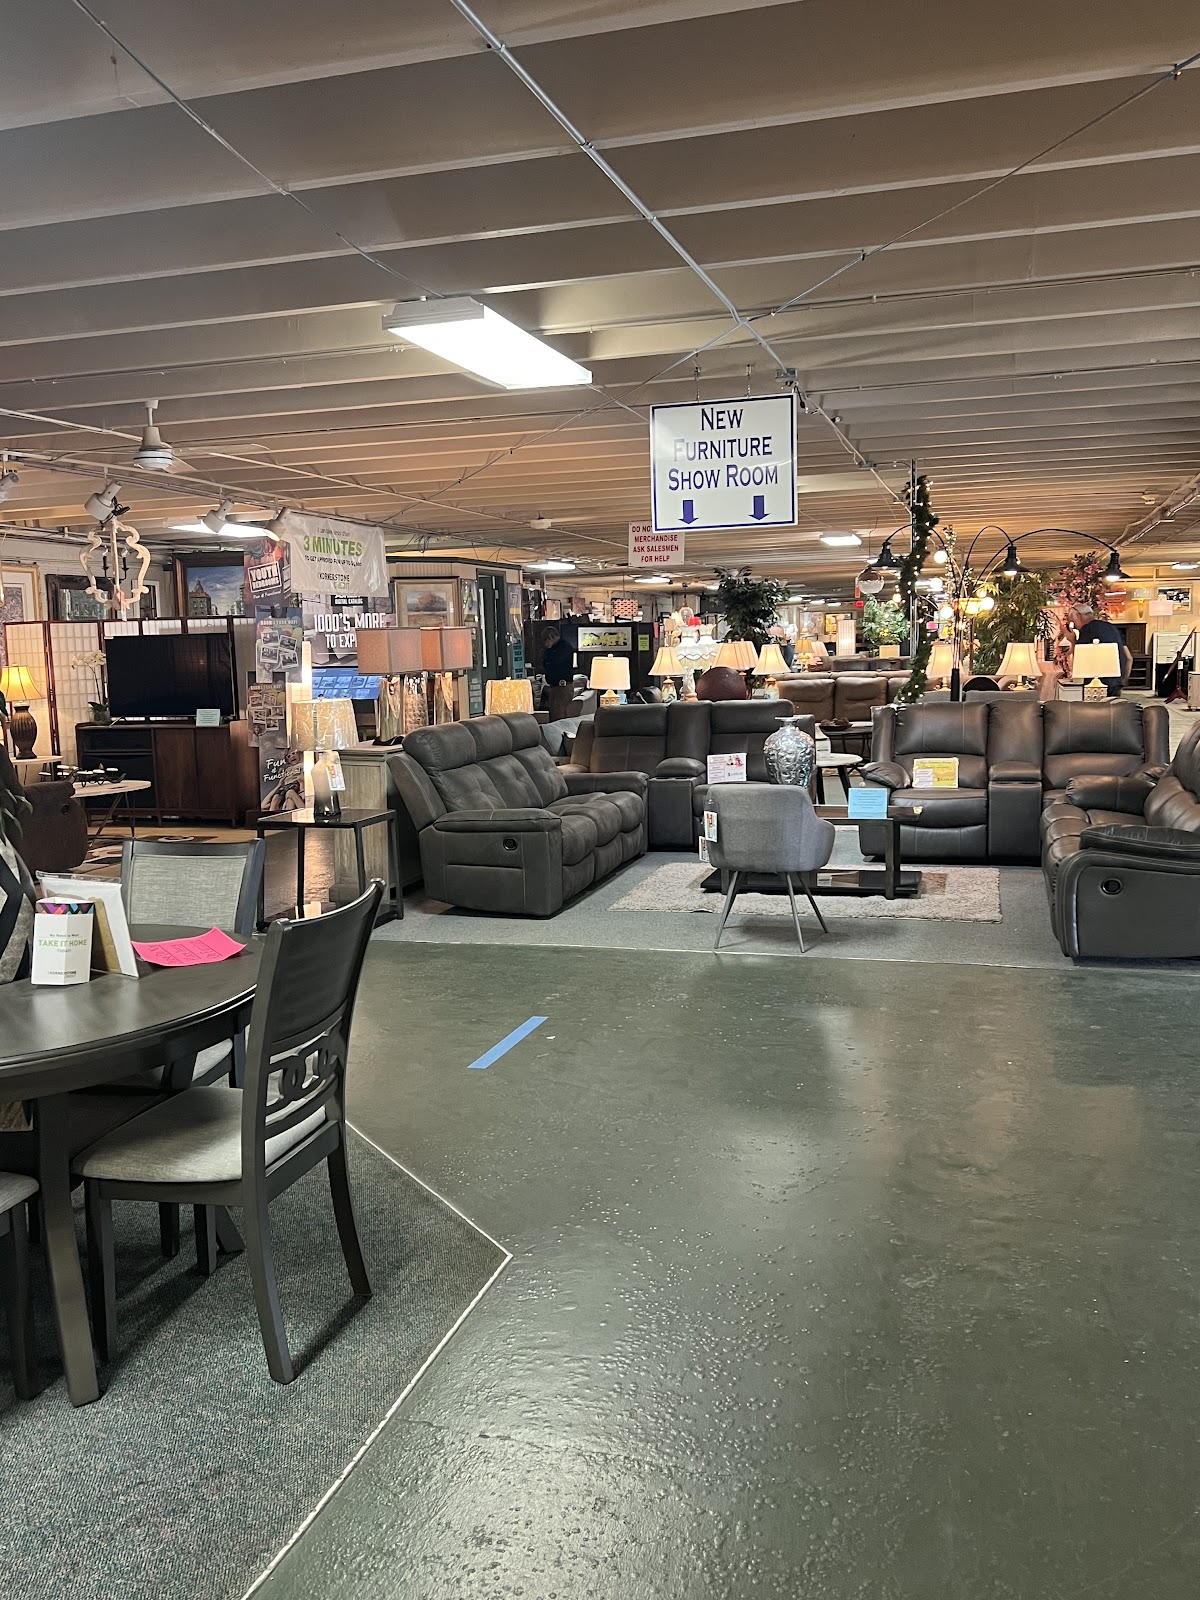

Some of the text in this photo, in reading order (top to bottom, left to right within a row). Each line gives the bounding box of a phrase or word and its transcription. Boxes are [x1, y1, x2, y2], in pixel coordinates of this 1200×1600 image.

[701, 407, 743, 431] NEW
[673, 436, 773, 462] FURNITURE
[668, 464, 778, 491] SHOW ROOM
[304, 535, 363, 556] 3 MINUTES
[634, 534, 678, 542] MERCHANDISE
[646, 544, 679, 552] SALESMEN
[250, 564, 278, 582] YOUTH
[252, 577, 280, 590] BEDROOMS
[314, 612, 386, 632] 1000'S MORE
[325, 634, 336, 648] TO
[266, 758, 286, 770] Fun
[263, 767, 301, 782] Functional
[69, 938, 87, 946] HOME
